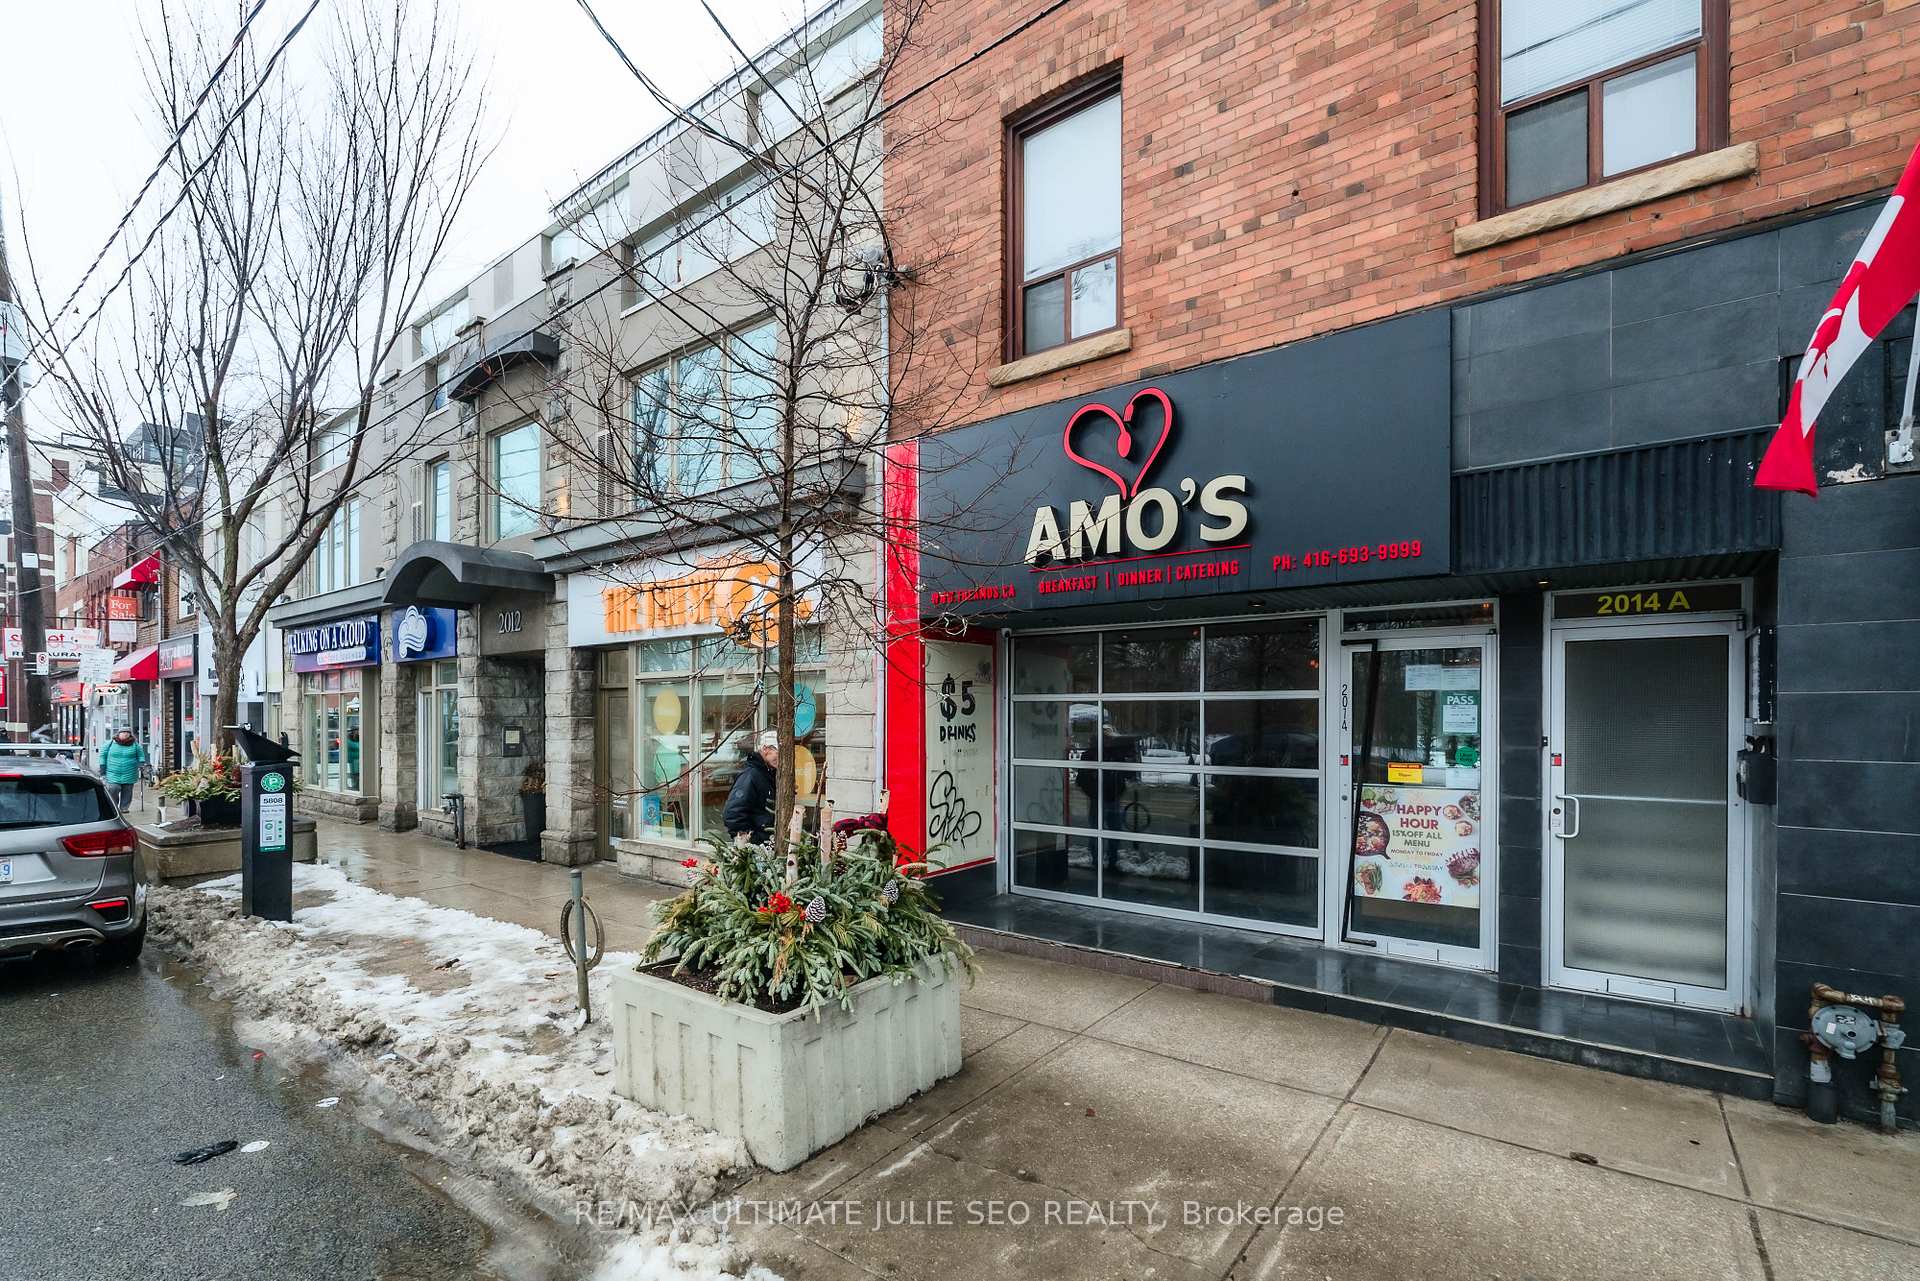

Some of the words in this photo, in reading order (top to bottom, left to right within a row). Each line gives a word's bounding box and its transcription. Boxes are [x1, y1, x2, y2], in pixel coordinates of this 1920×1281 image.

[1023, 474, 1249, 566] AMO'S
[1272, 555, 1297, 572] PH:
[1303, 540, 1422, 568] 416-693-9999
[1038, 576, 1098, 595] BREAKFAST
[1118, 568, 1162, 587] DINNER
[1176, 560, 1239, 580] CATERING
[111, 599, 132, 610] For
[1597, 591, 1661, 614] 2014
[1667, 590, 1691, 611] A
[498, 610, 522, 633] 2012
[320, 627, 331, 651] ON
[331, 625, 338, 649] A
[340, 620, 366, 648] CLOUD
[940, 673, 976, 722] $5
[1446, 695, 1474, 705] PASS
[940, 723, 976, 743] DRINKS
[1396, 804, 1442, 816] HAPPY
[1400, 818, 1439, 829] HOUR
[1426, 831, 1443, 840] ALL
